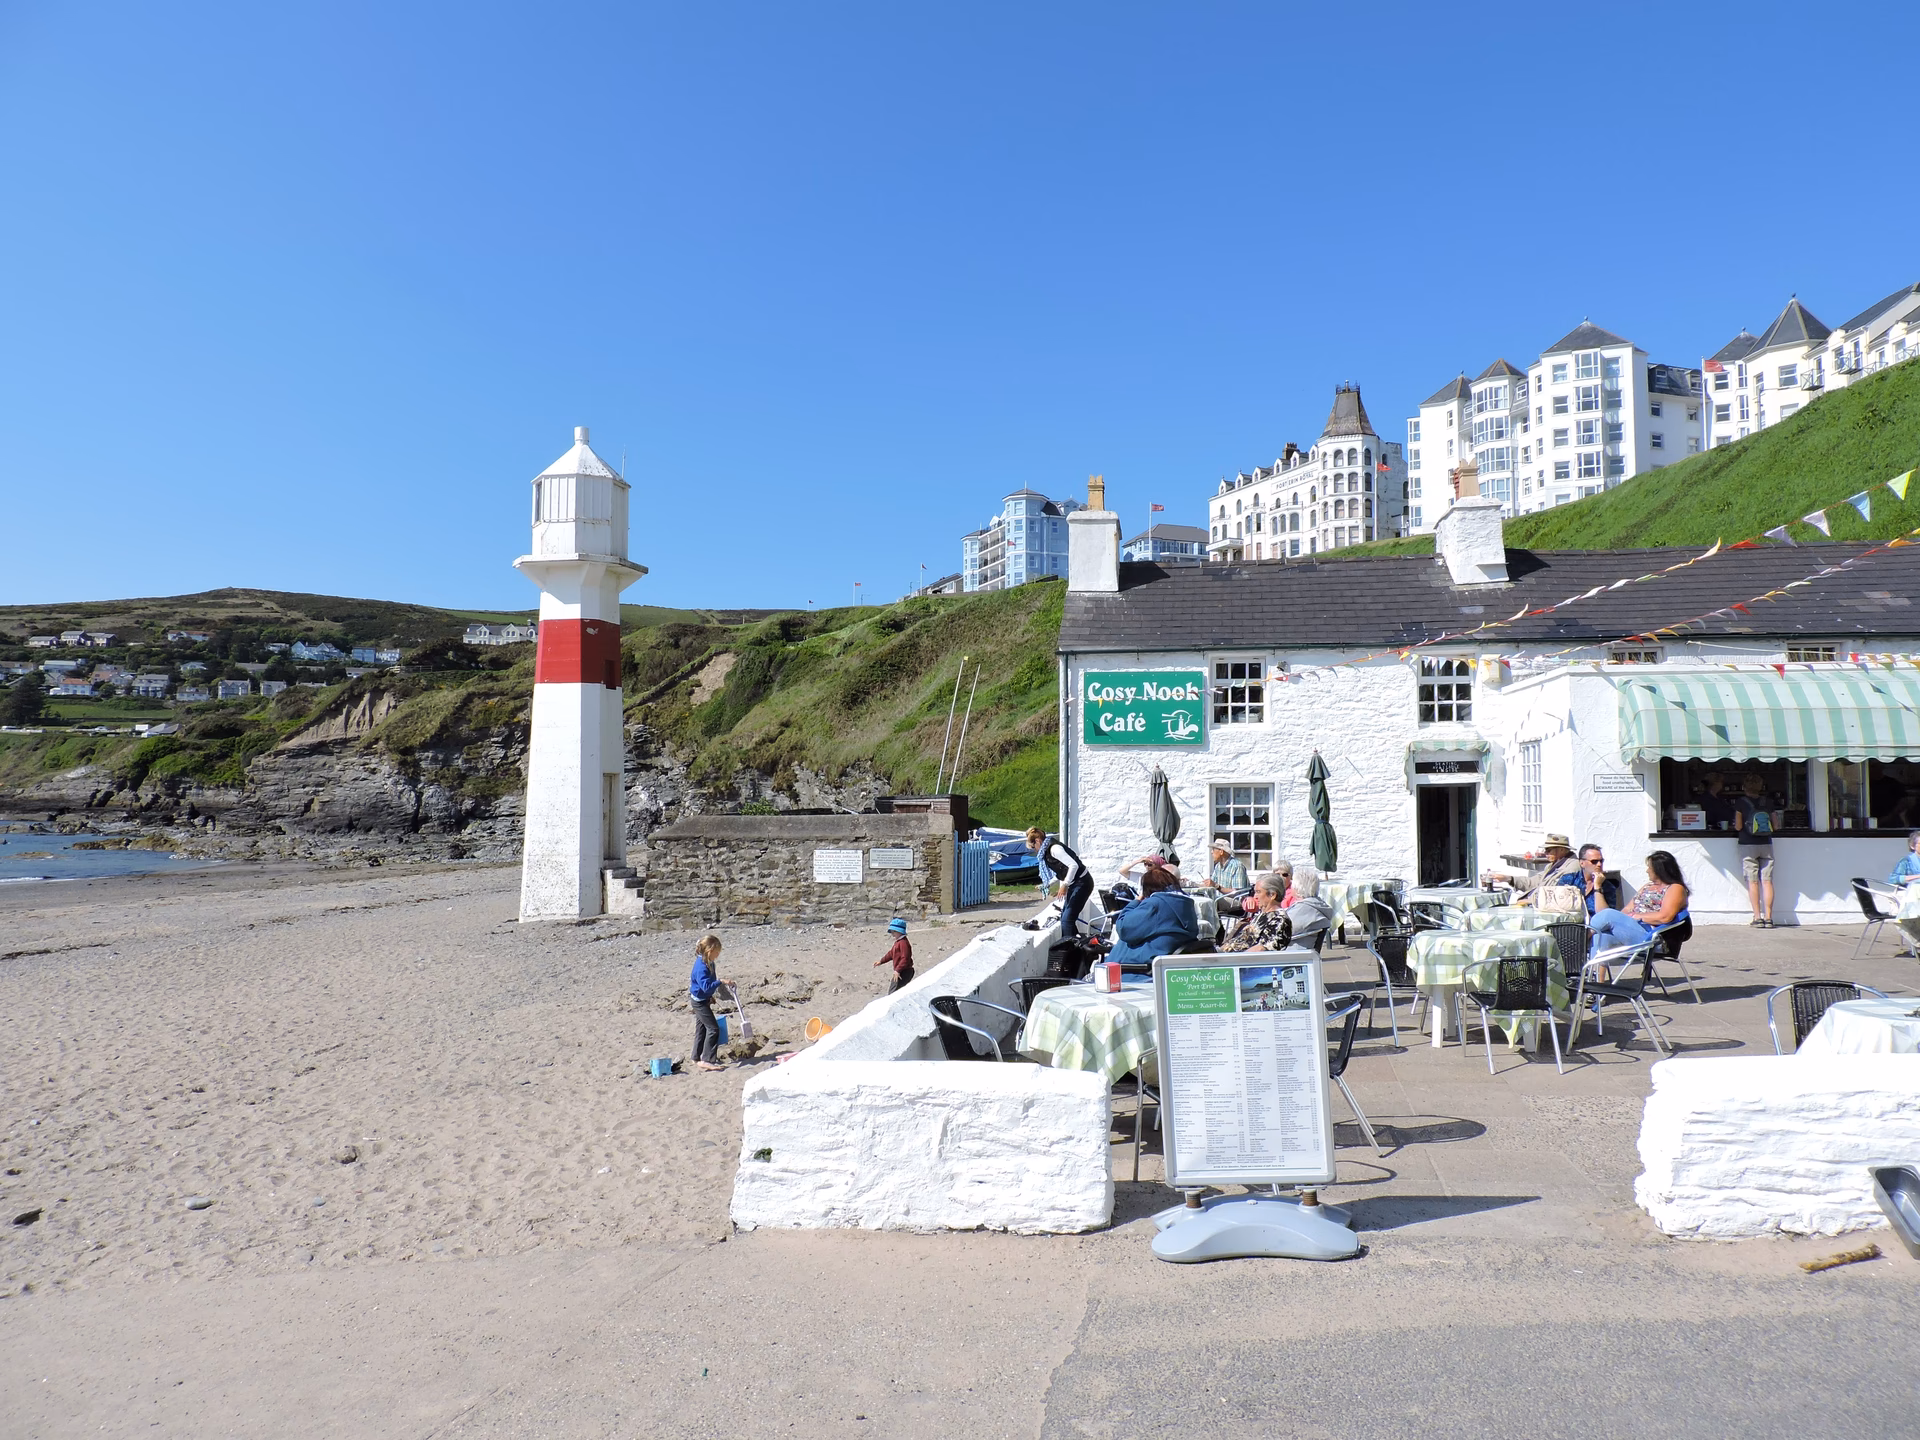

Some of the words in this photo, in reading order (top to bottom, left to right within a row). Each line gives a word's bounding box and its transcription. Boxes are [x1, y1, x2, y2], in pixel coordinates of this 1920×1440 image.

[1276, 481, 1287, 489] PORT
[1087, 681, 1137, 705] Cosy
[1143, 681, 1199, 701] Nook
[1100, 712, 1146, 732] Café
[1170, 975, 1189, 985] Cosy
[1191, 972, 1212, 982] Nook
[1213, 971, 1231, 984] Cafe
